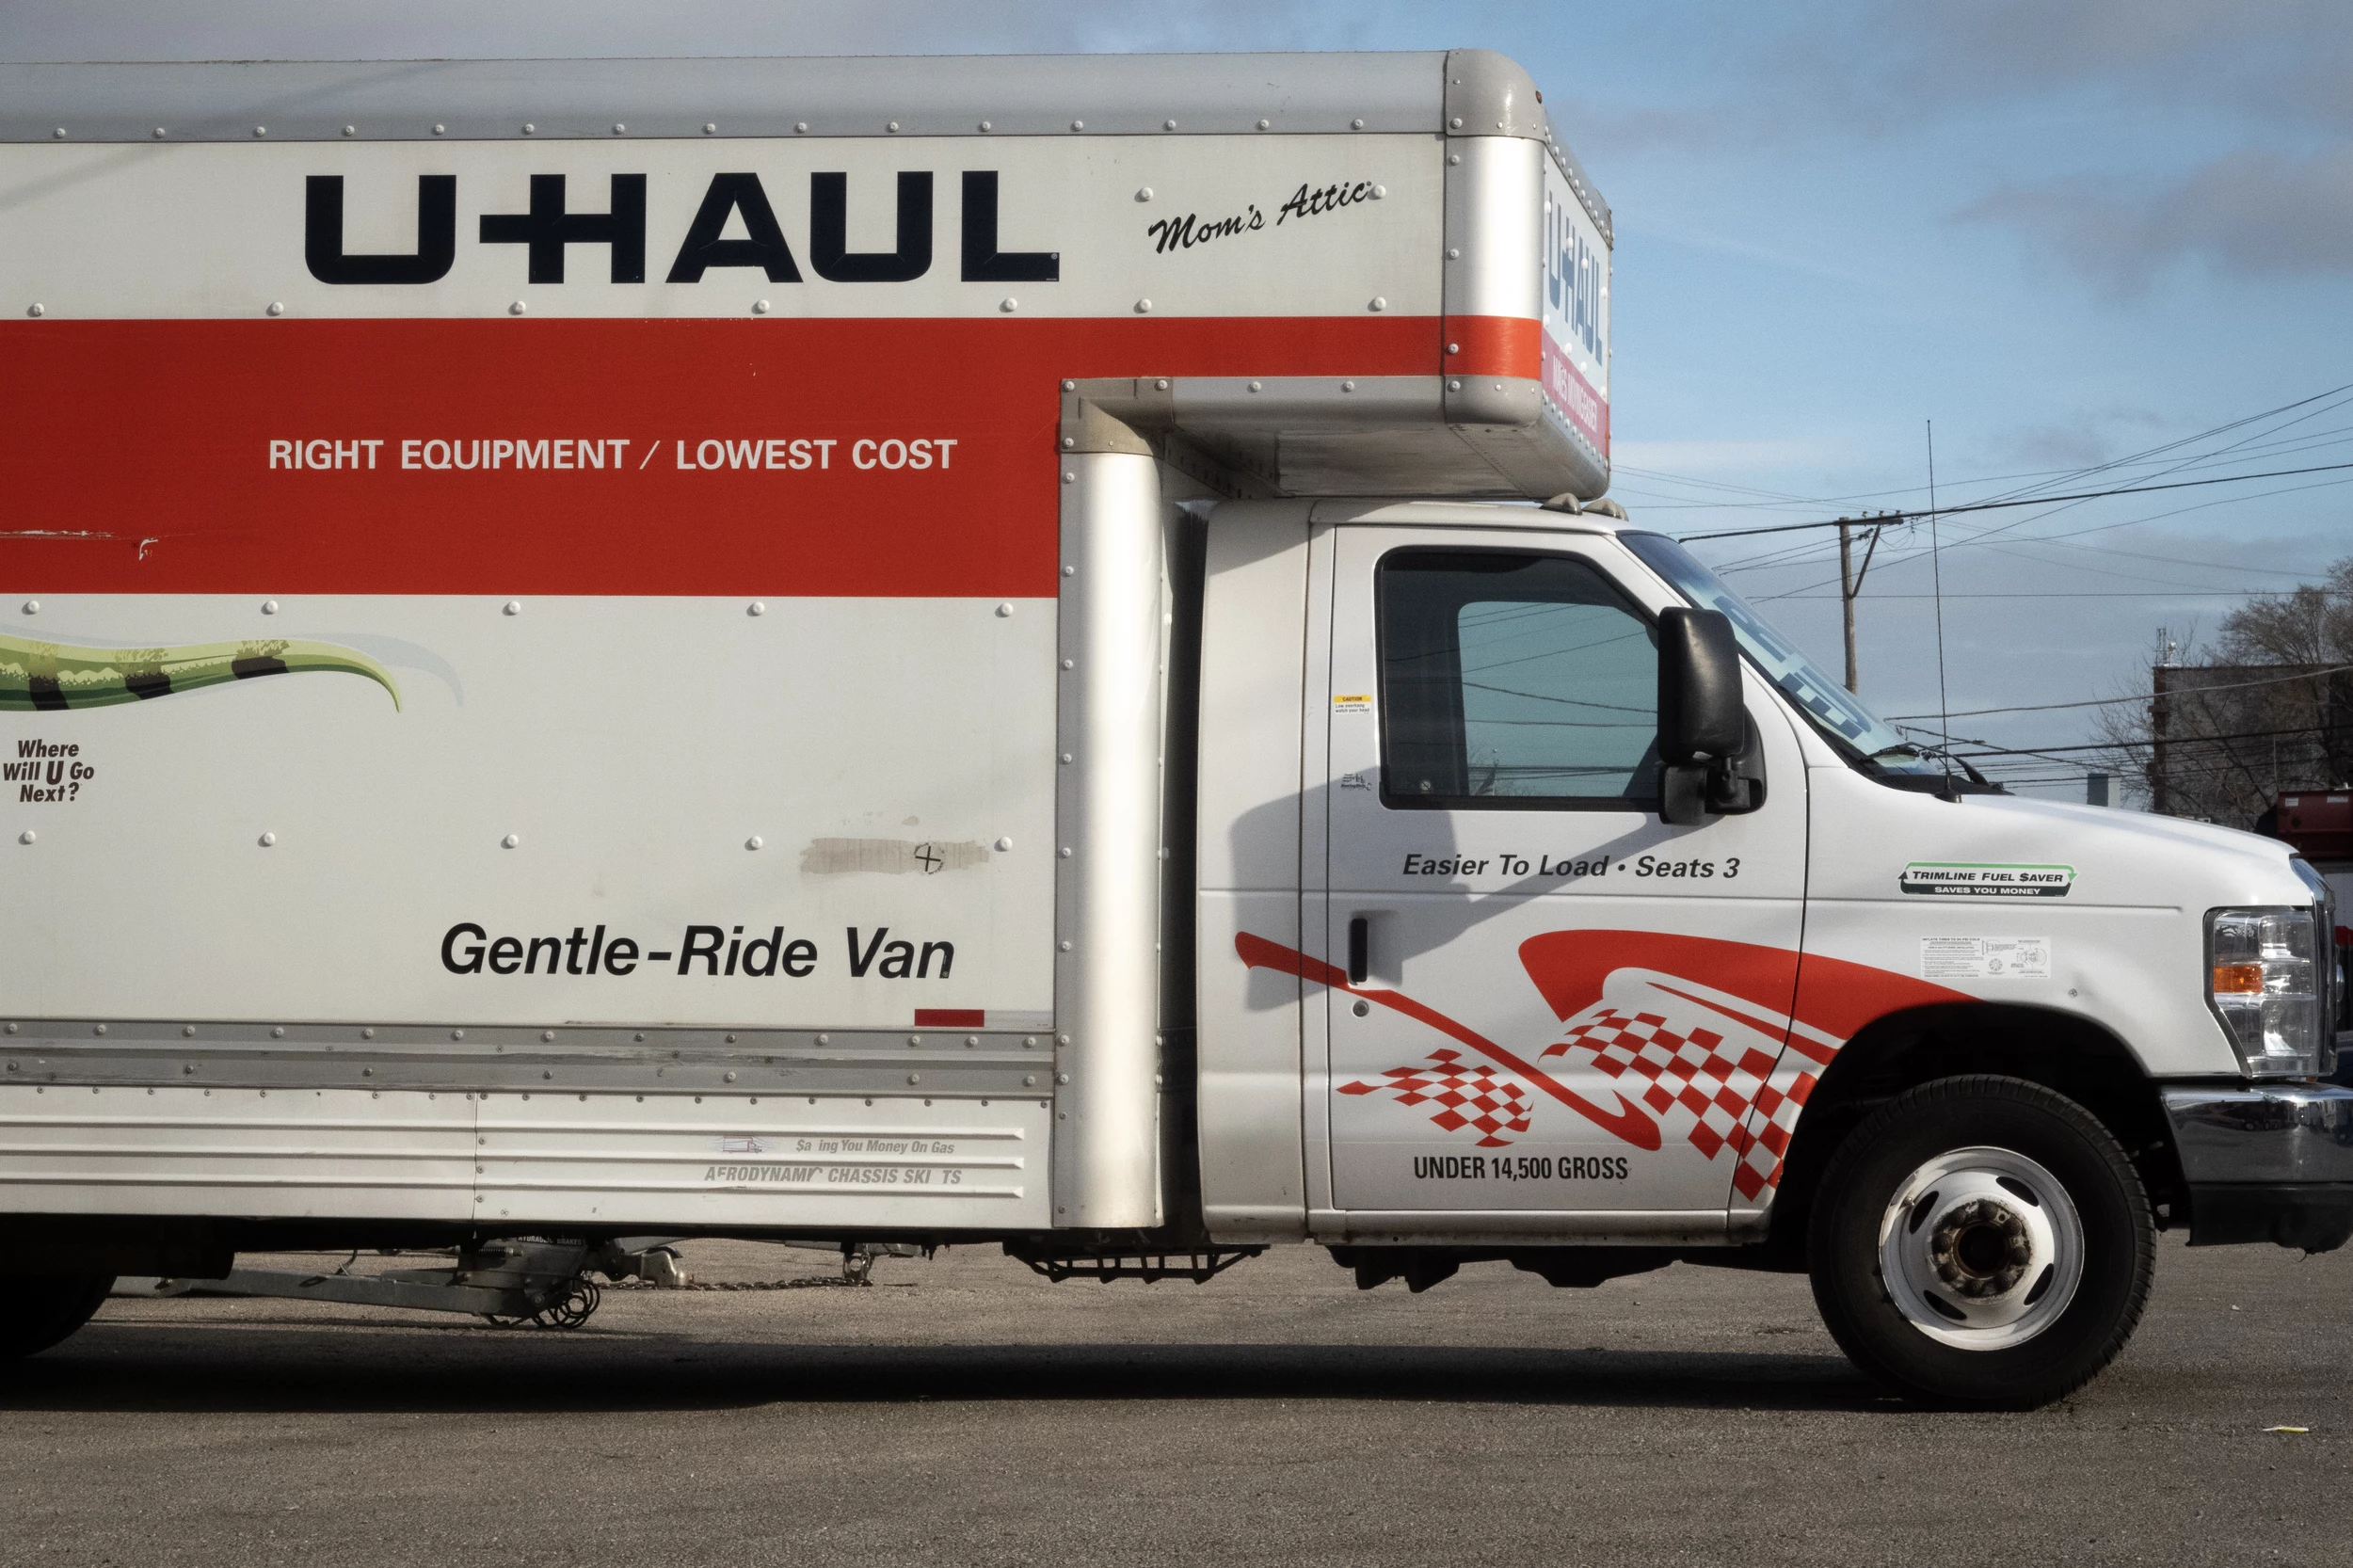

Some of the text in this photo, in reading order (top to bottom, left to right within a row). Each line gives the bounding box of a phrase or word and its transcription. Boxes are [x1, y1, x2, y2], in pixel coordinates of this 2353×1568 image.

[1148, 181, 1368, 254] Mom's Attic
[269, 439, 384, 470] RIGHT
[401, 439, 631, 470] EQUIPMENT
[677, 439, 838, 471] LOWEST
[852, 439, 958, 470] COST
[18, 739, 79, 758] Where
[3, 760, 94, 785] Will U Go
[20, 781, 80, 802] Next?
[1402, 853, 1740, 879] Easier To Load Seats 3
[1981, 872, 2015, 882] FUEL
[846, 926, 954, 979] Van
[841, 1139, 863, 1152] You
[866, 1140, 908, 1156] Money
[911, 1142, 928, 1154] On
[931, 1142, 954, 1155] Gas
[827, 1167, 898, 1184] CHASSIS
[903, 1169, 963, 1185] SKITS
[1414, 1156, 1628, 1182] UNDER 14,500 GROSS
